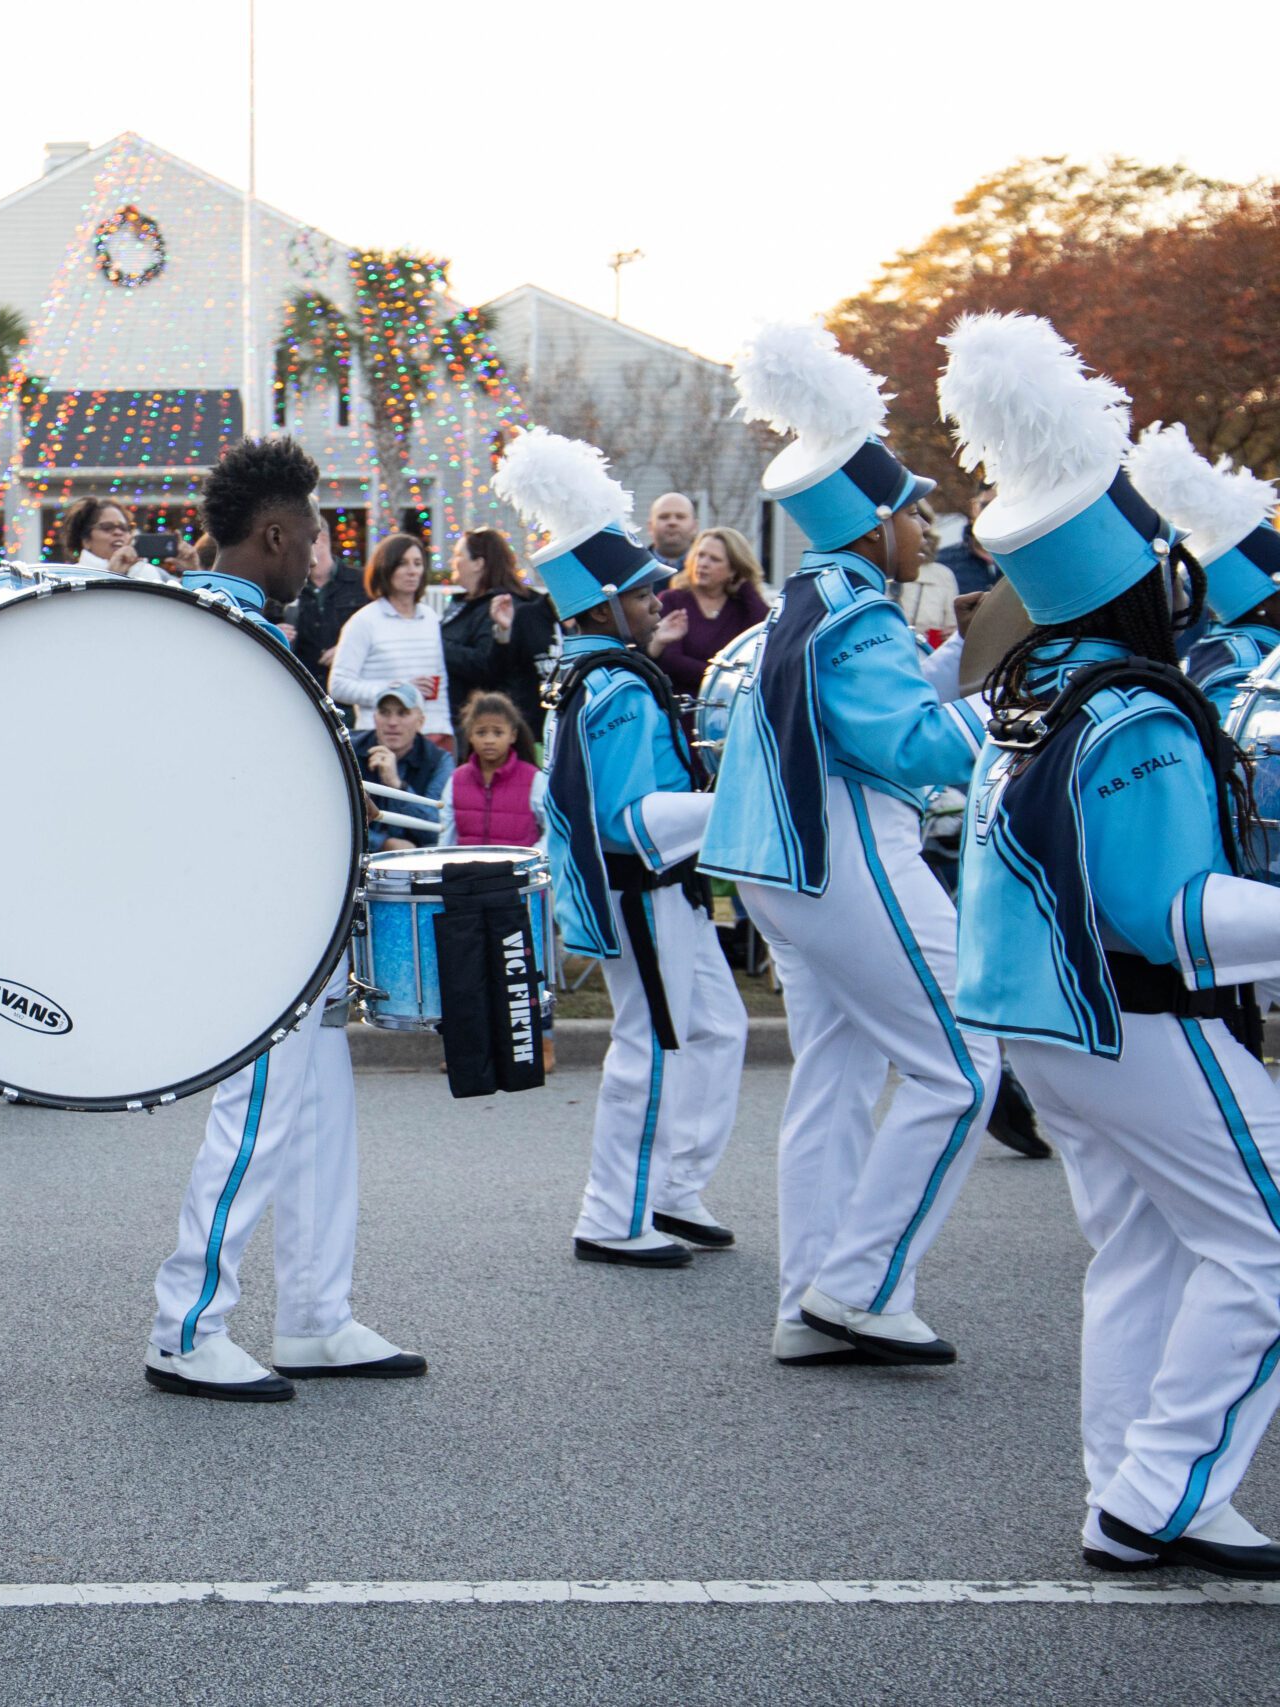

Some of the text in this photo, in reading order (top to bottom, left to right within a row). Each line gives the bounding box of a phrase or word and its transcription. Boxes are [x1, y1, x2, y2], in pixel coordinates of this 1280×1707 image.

[831, 633, 893, 668] R.B. STALL
[1098, 752, 1182, 799] R.B. STALL
[502, 930, 537, 1063] VIC FIRTH
